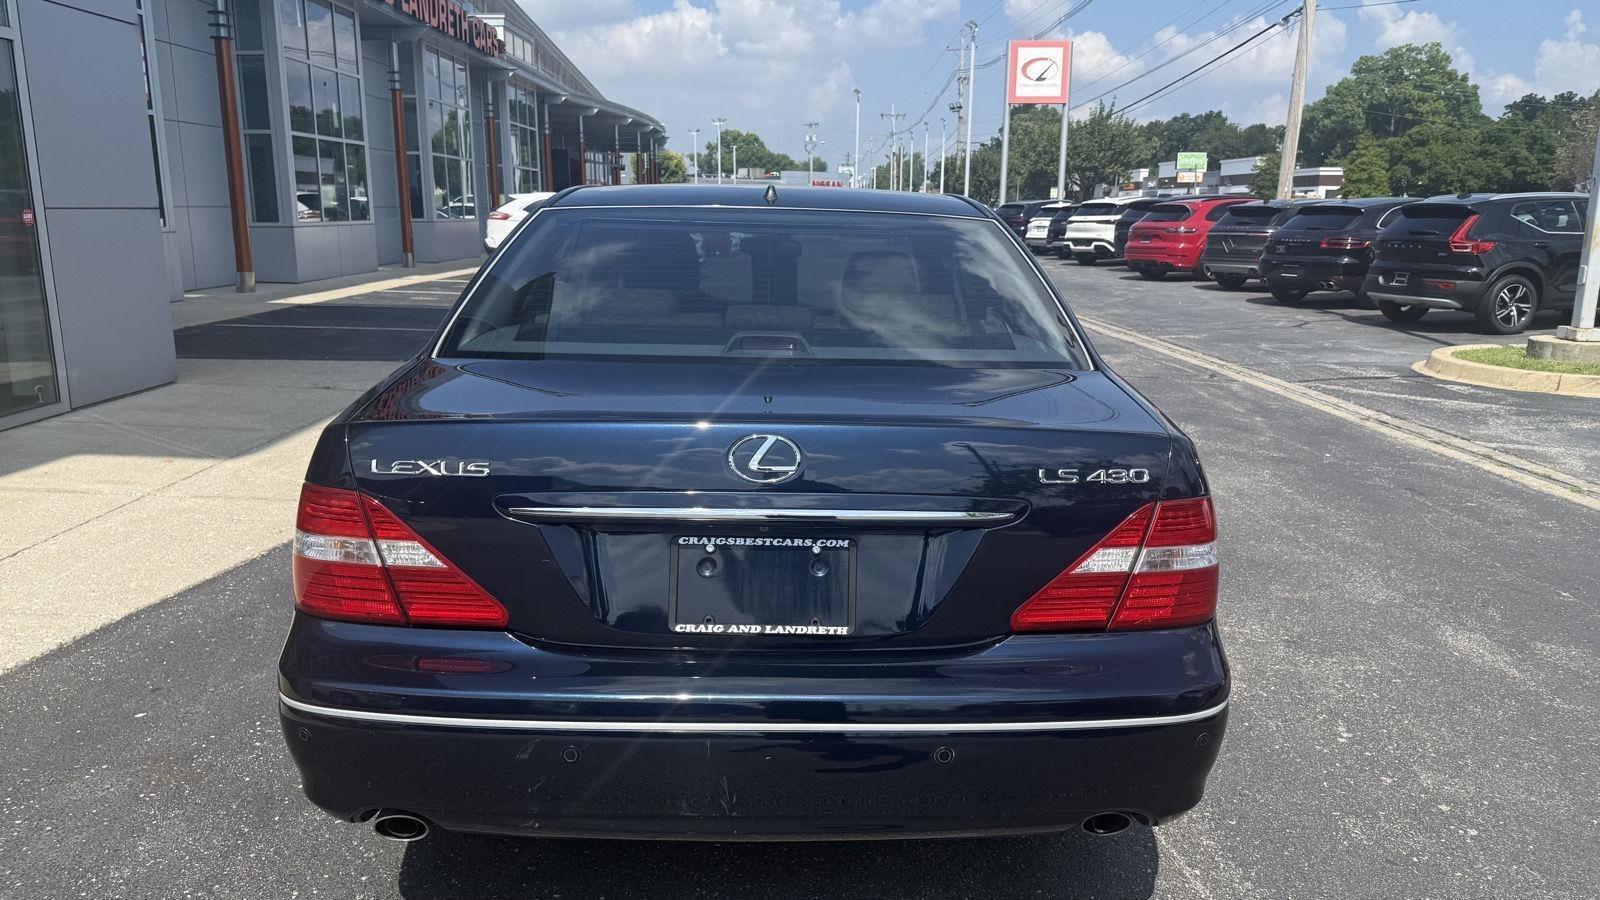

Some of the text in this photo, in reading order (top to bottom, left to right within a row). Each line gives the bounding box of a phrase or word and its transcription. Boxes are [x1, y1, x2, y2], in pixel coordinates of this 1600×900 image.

[472, 16, 499, 58] CARS
[371, 459, 490, 477] LEXUS
[1038, 468, 1150, 484] LS 430
[678, 536, 850, 548] CRAIGSBESTCARS.COM
[674, 624, 849, 635] CRAIG AND LANDRETH
